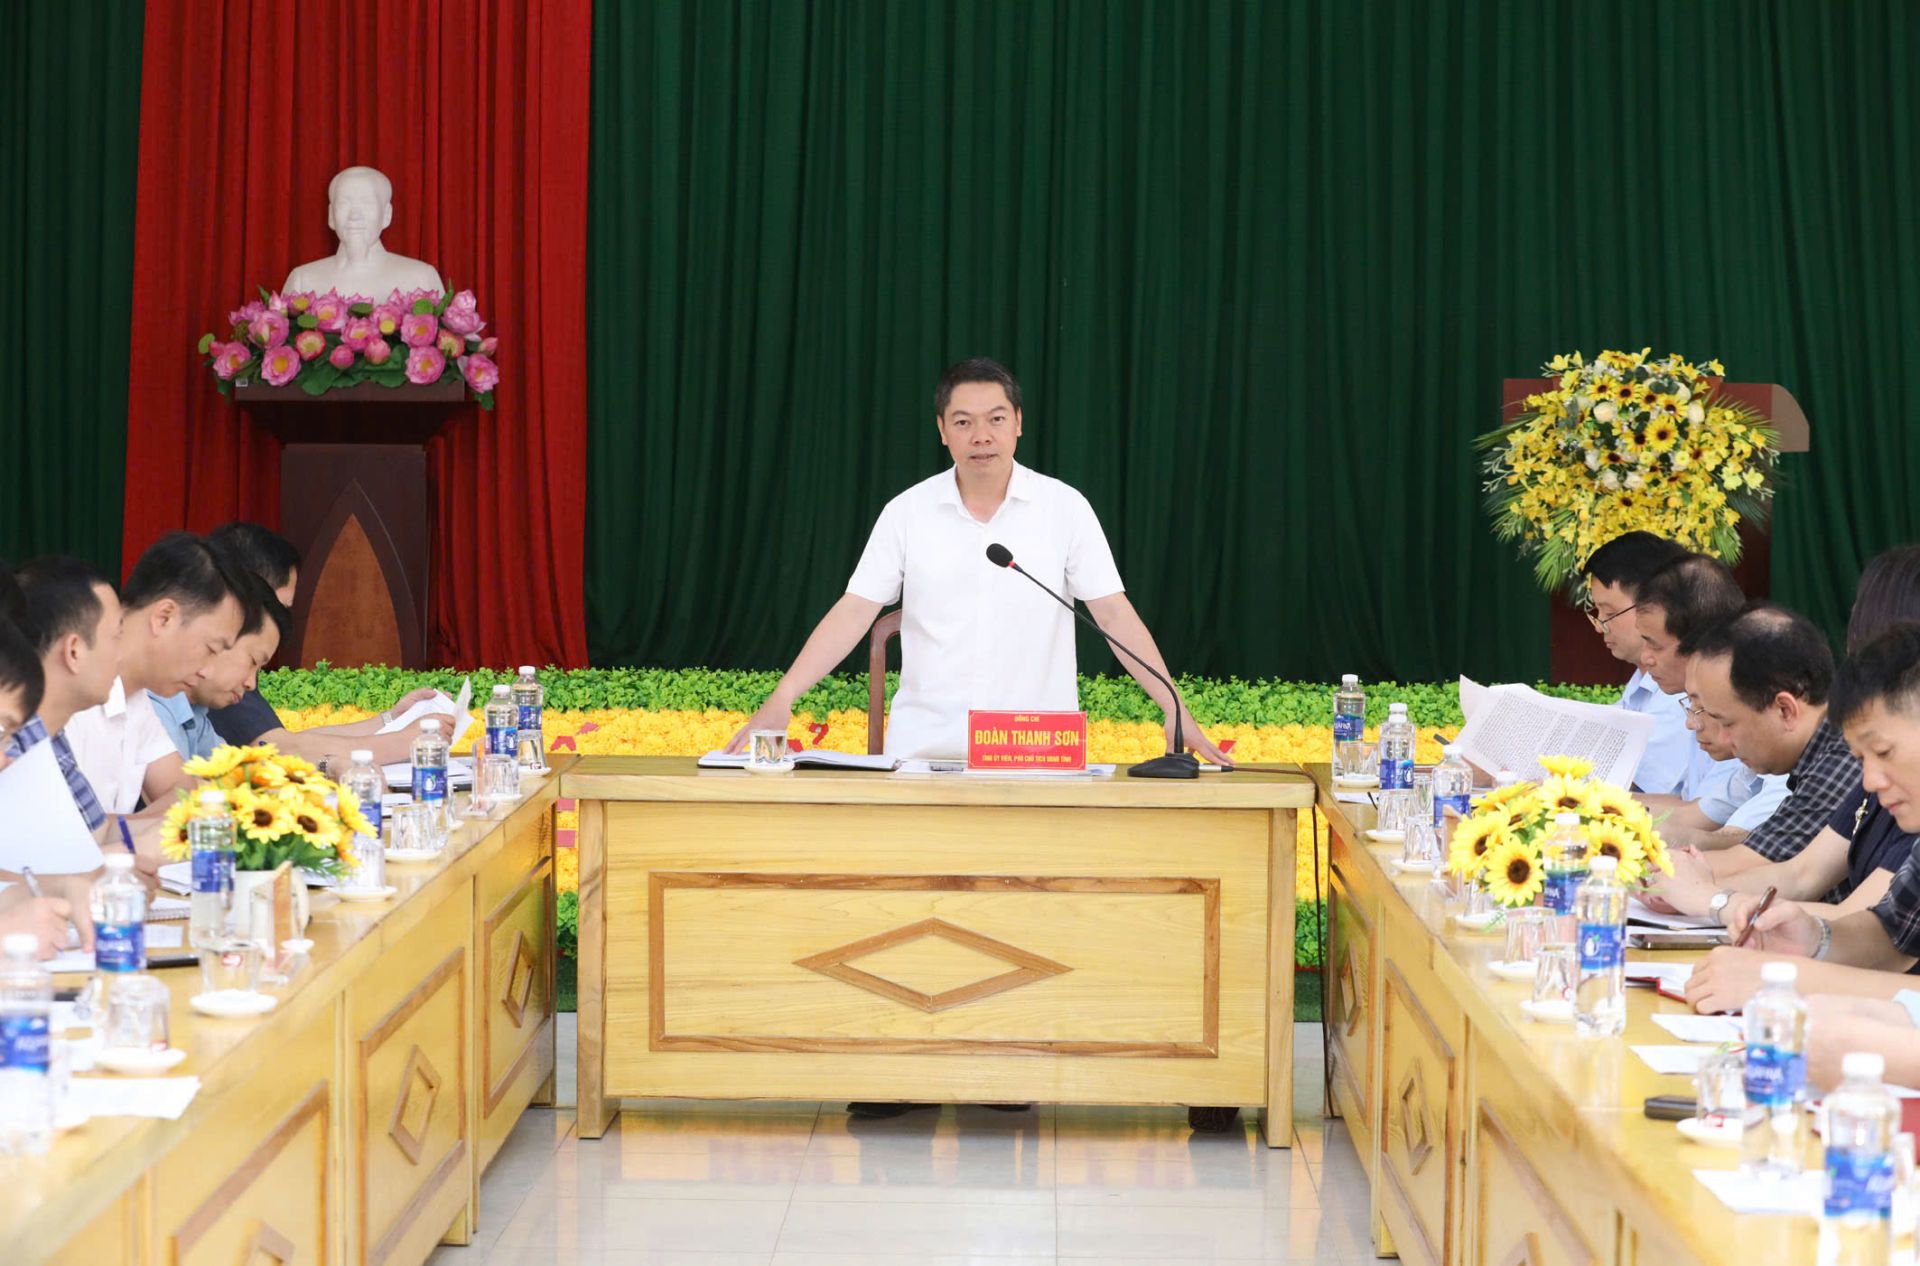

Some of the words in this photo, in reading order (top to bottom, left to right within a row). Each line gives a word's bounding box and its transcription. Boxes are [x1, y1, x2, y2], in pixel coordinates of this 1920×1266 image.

[975, 726, 1008, 745] ĐOÀN
[1011, 730, 1051, 746] THANH
[1054, 730, 1080, 746] SƠN
